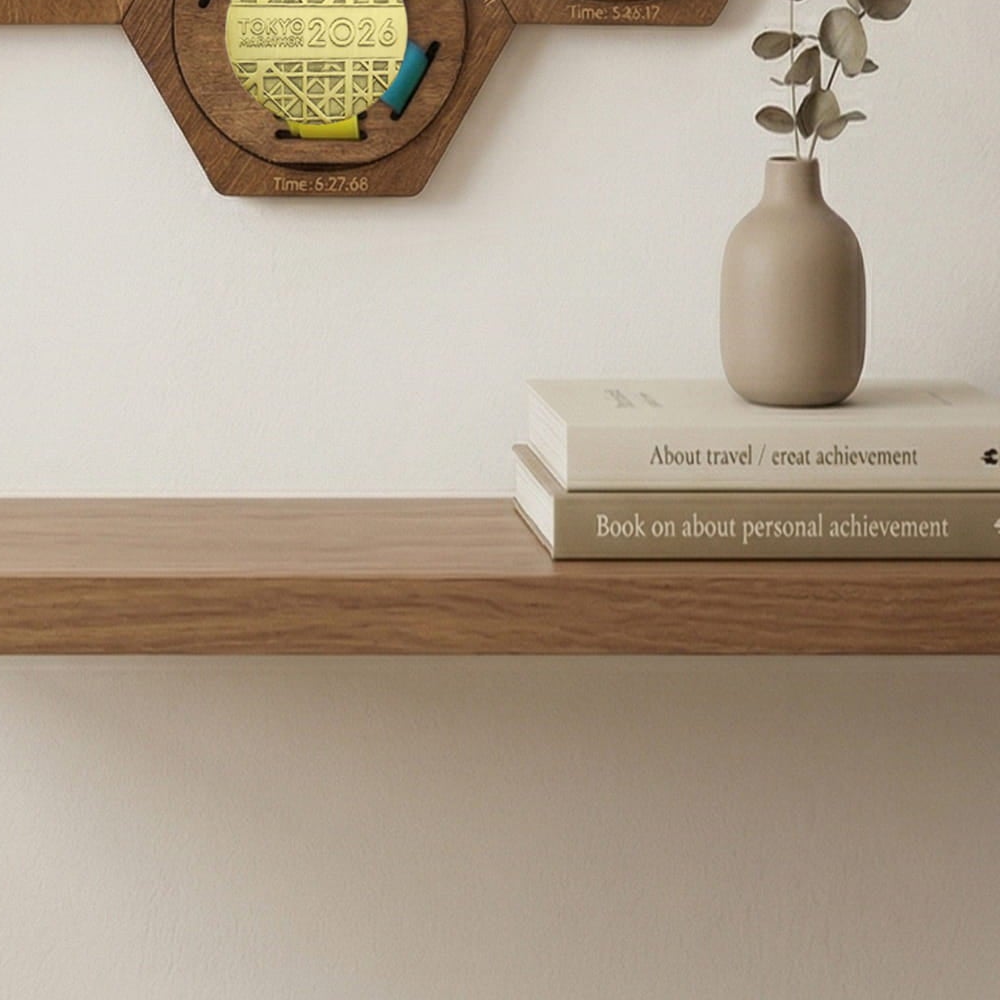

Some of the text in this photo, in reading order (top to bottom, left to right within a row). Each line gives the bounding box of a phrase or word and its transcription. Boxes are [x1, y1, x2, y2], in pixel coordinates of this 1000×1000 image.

[238, 17, 398, 48] TOKYO 2026
[650, 444, 701, 466] About
[706, 444, 753, 466] travel
[758, 444, 767, 466] /
[816, 444, 918, 466] achievement
[596, 514, 950, 544] Book on about personal achievement
